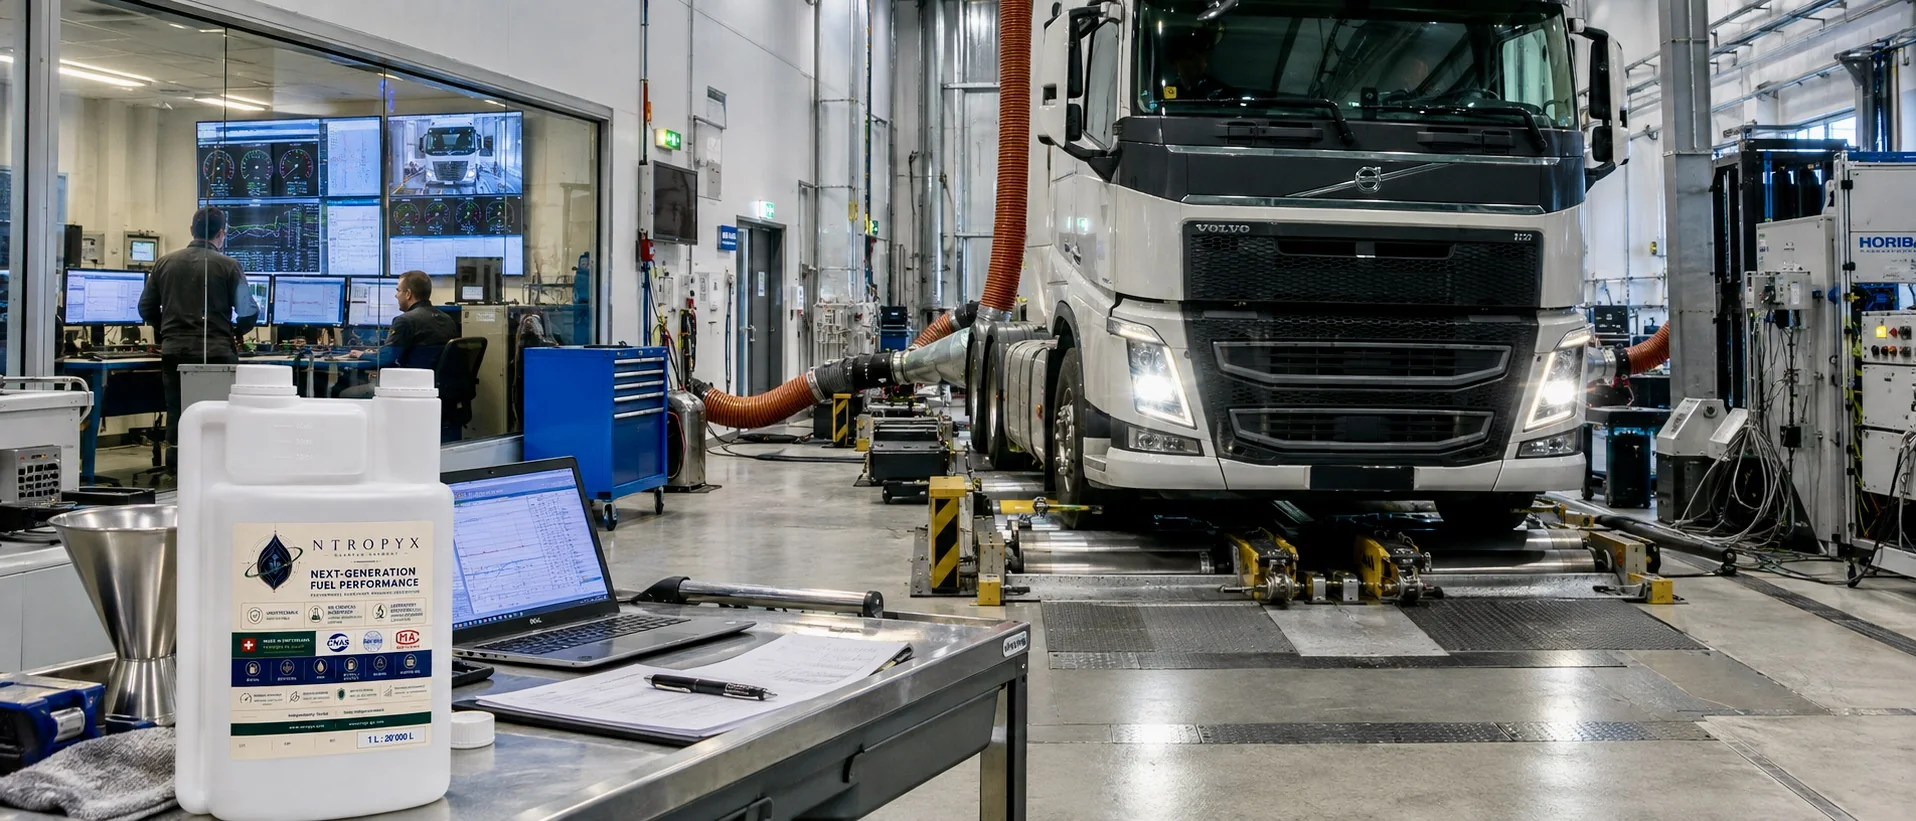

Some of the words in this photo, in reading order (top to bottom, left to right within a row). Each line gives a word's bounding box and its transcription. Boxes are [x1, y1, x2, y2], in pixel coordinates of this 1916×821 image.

[1195, 223, 1251, 234] VOLVO
[312, 537, 420, 551] NTROPYX
[310, 566, 417, 579] NEXT-GENERATION
[310, 580, 337, 590] FUEL
[339, 577, 420, 590] PERFORMANCE
[326, 638, 350, 647] CNAS
[367, 735, 372, 743] 1
[374, 735, 380, 743] L
[384, 732, 408, 743] 20'000
[408, 732, 414, 740] L
